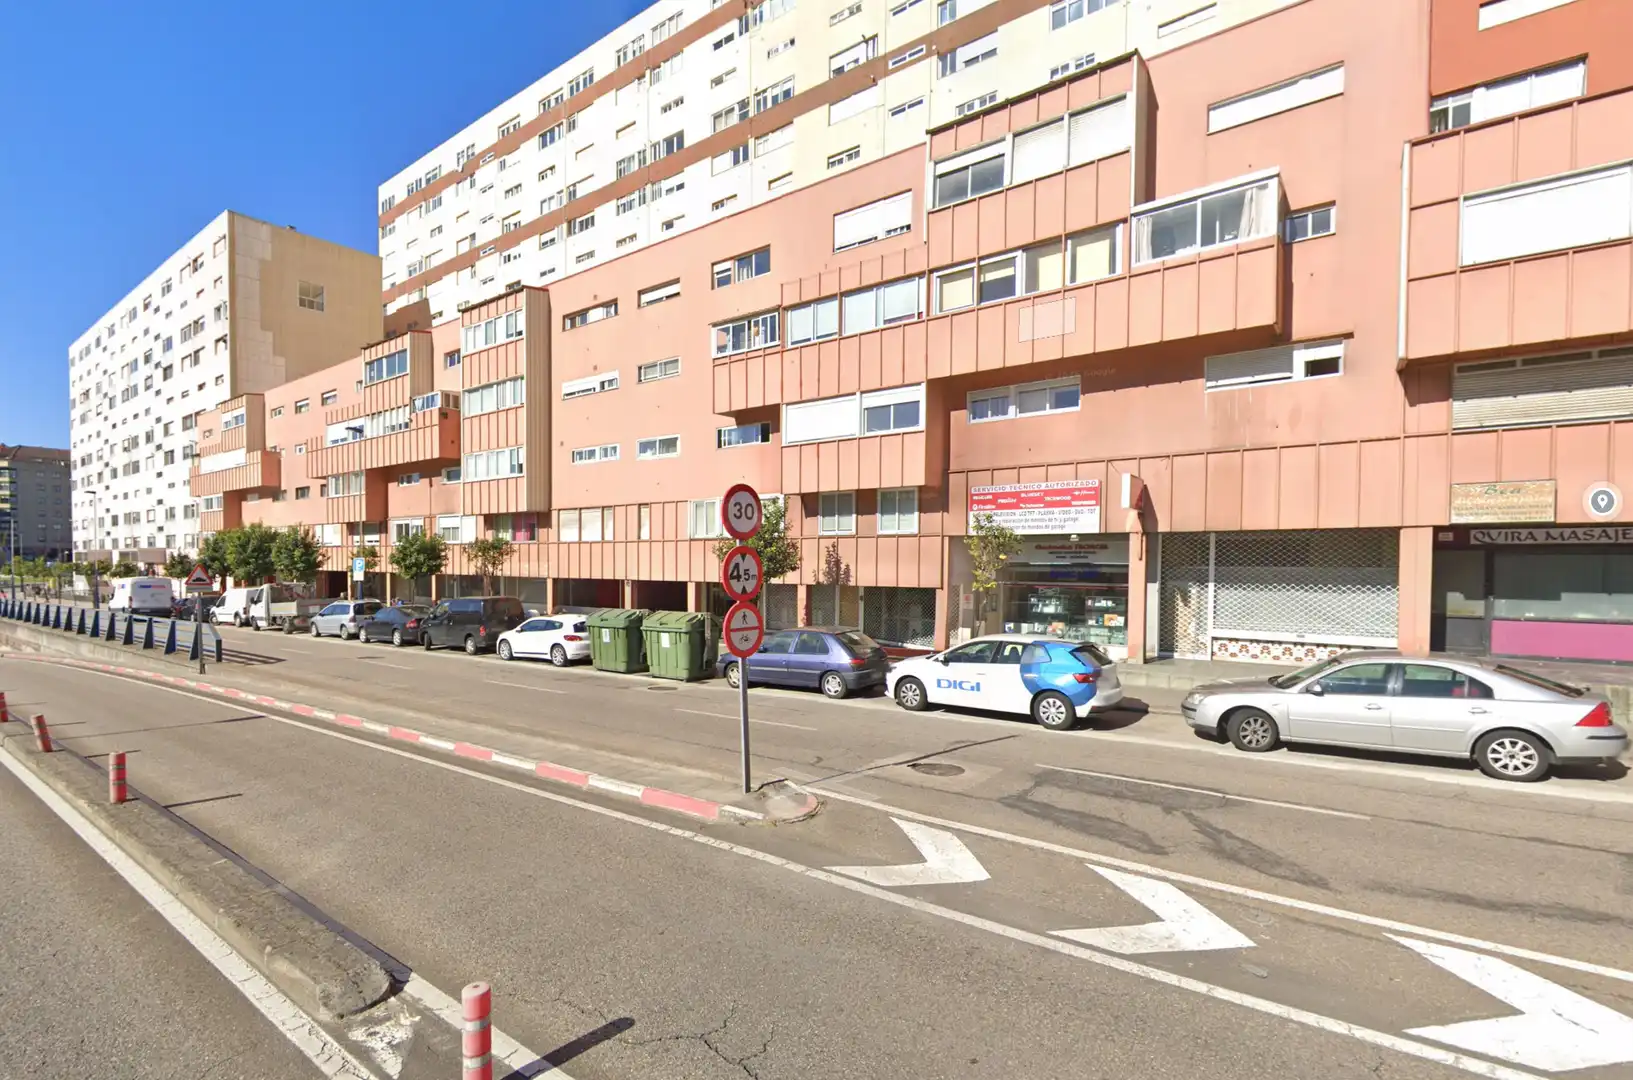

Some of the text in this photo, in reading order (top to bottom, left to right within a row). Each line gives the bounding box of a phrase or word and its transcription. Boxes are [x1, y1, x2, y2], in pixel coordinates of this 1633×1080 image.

[1045, 480, 1097, 489] AUTORIZADO
[733, 502, 755, 520] 30
[936, 678, 981, 692] DIGI
